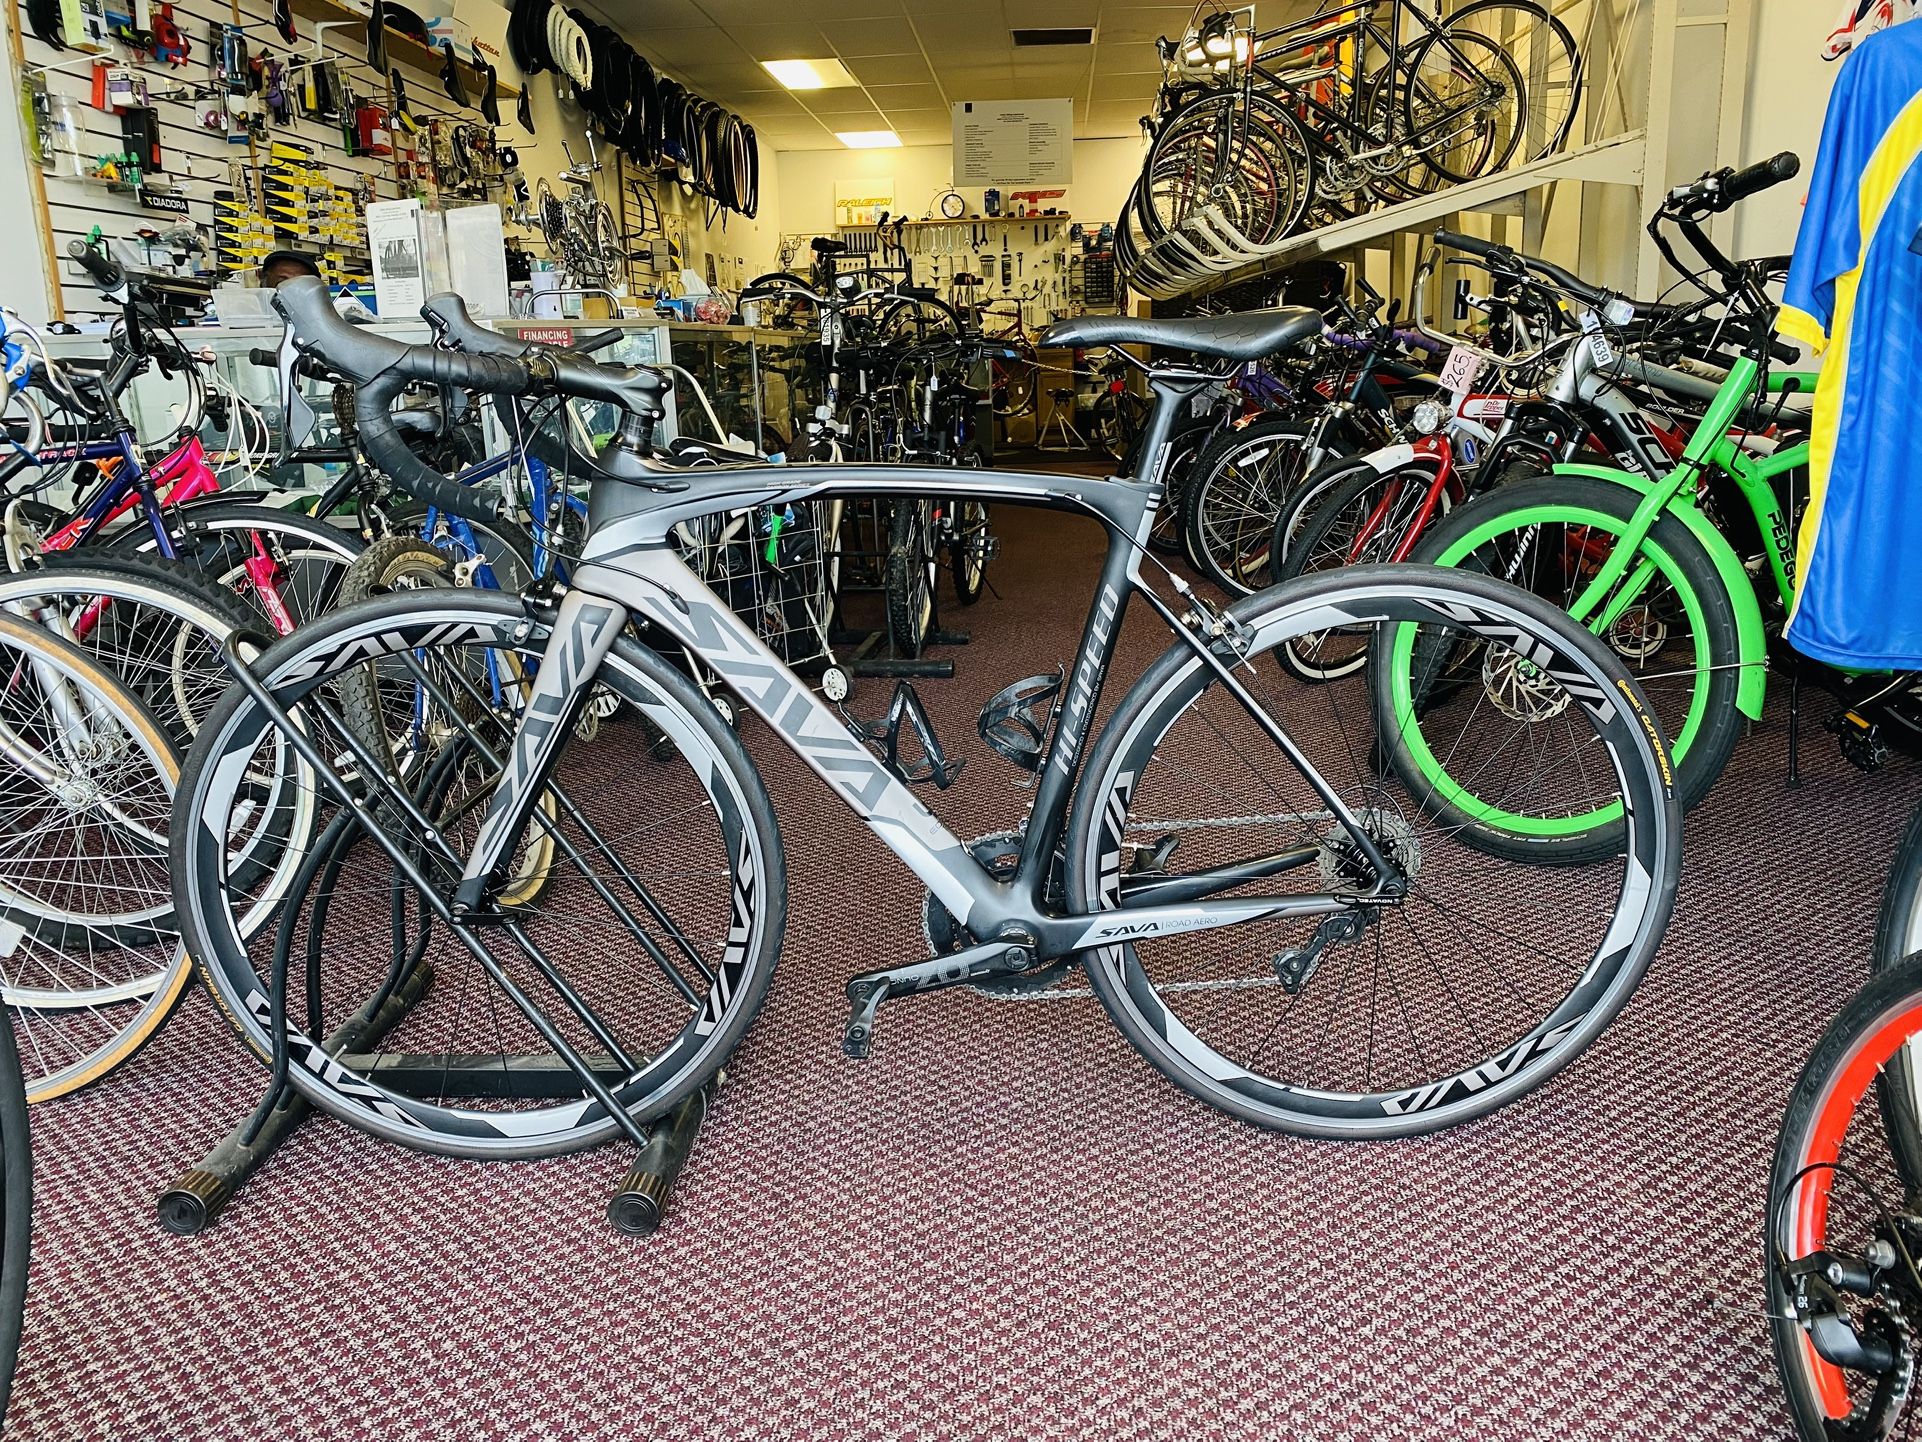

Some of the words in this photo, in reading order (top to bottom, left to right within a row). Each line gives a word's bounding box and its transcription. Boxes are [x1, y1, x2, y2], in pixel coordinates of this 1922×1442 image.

[152, 196, 188, 211] DIADORA
[836, 197, 893, 208] RALEIGH
[523, 329, 569, 341] FINANCING
[1586, 320, 1610, 362] 14639
[1645, 402, 1686, 415] BOULDER
[1054, 583, 1119, 776] HI-SPEED
[643, 596, 893, 812] SAVA
[1616, 679, 1642, 712] Continental
[1641, 714, 1673, 786] GATORSKIN
[1095, 922, 1160, 939] SAVA
[1165, 920, 1192, 929] ROAD
[1194, 916, 1219, 926] AERO
[889, 974, 920, 986] OUNC
[199, 966, 245, 1033] GATORSKIN
[1797, 1296, 1808, 1309] 26
